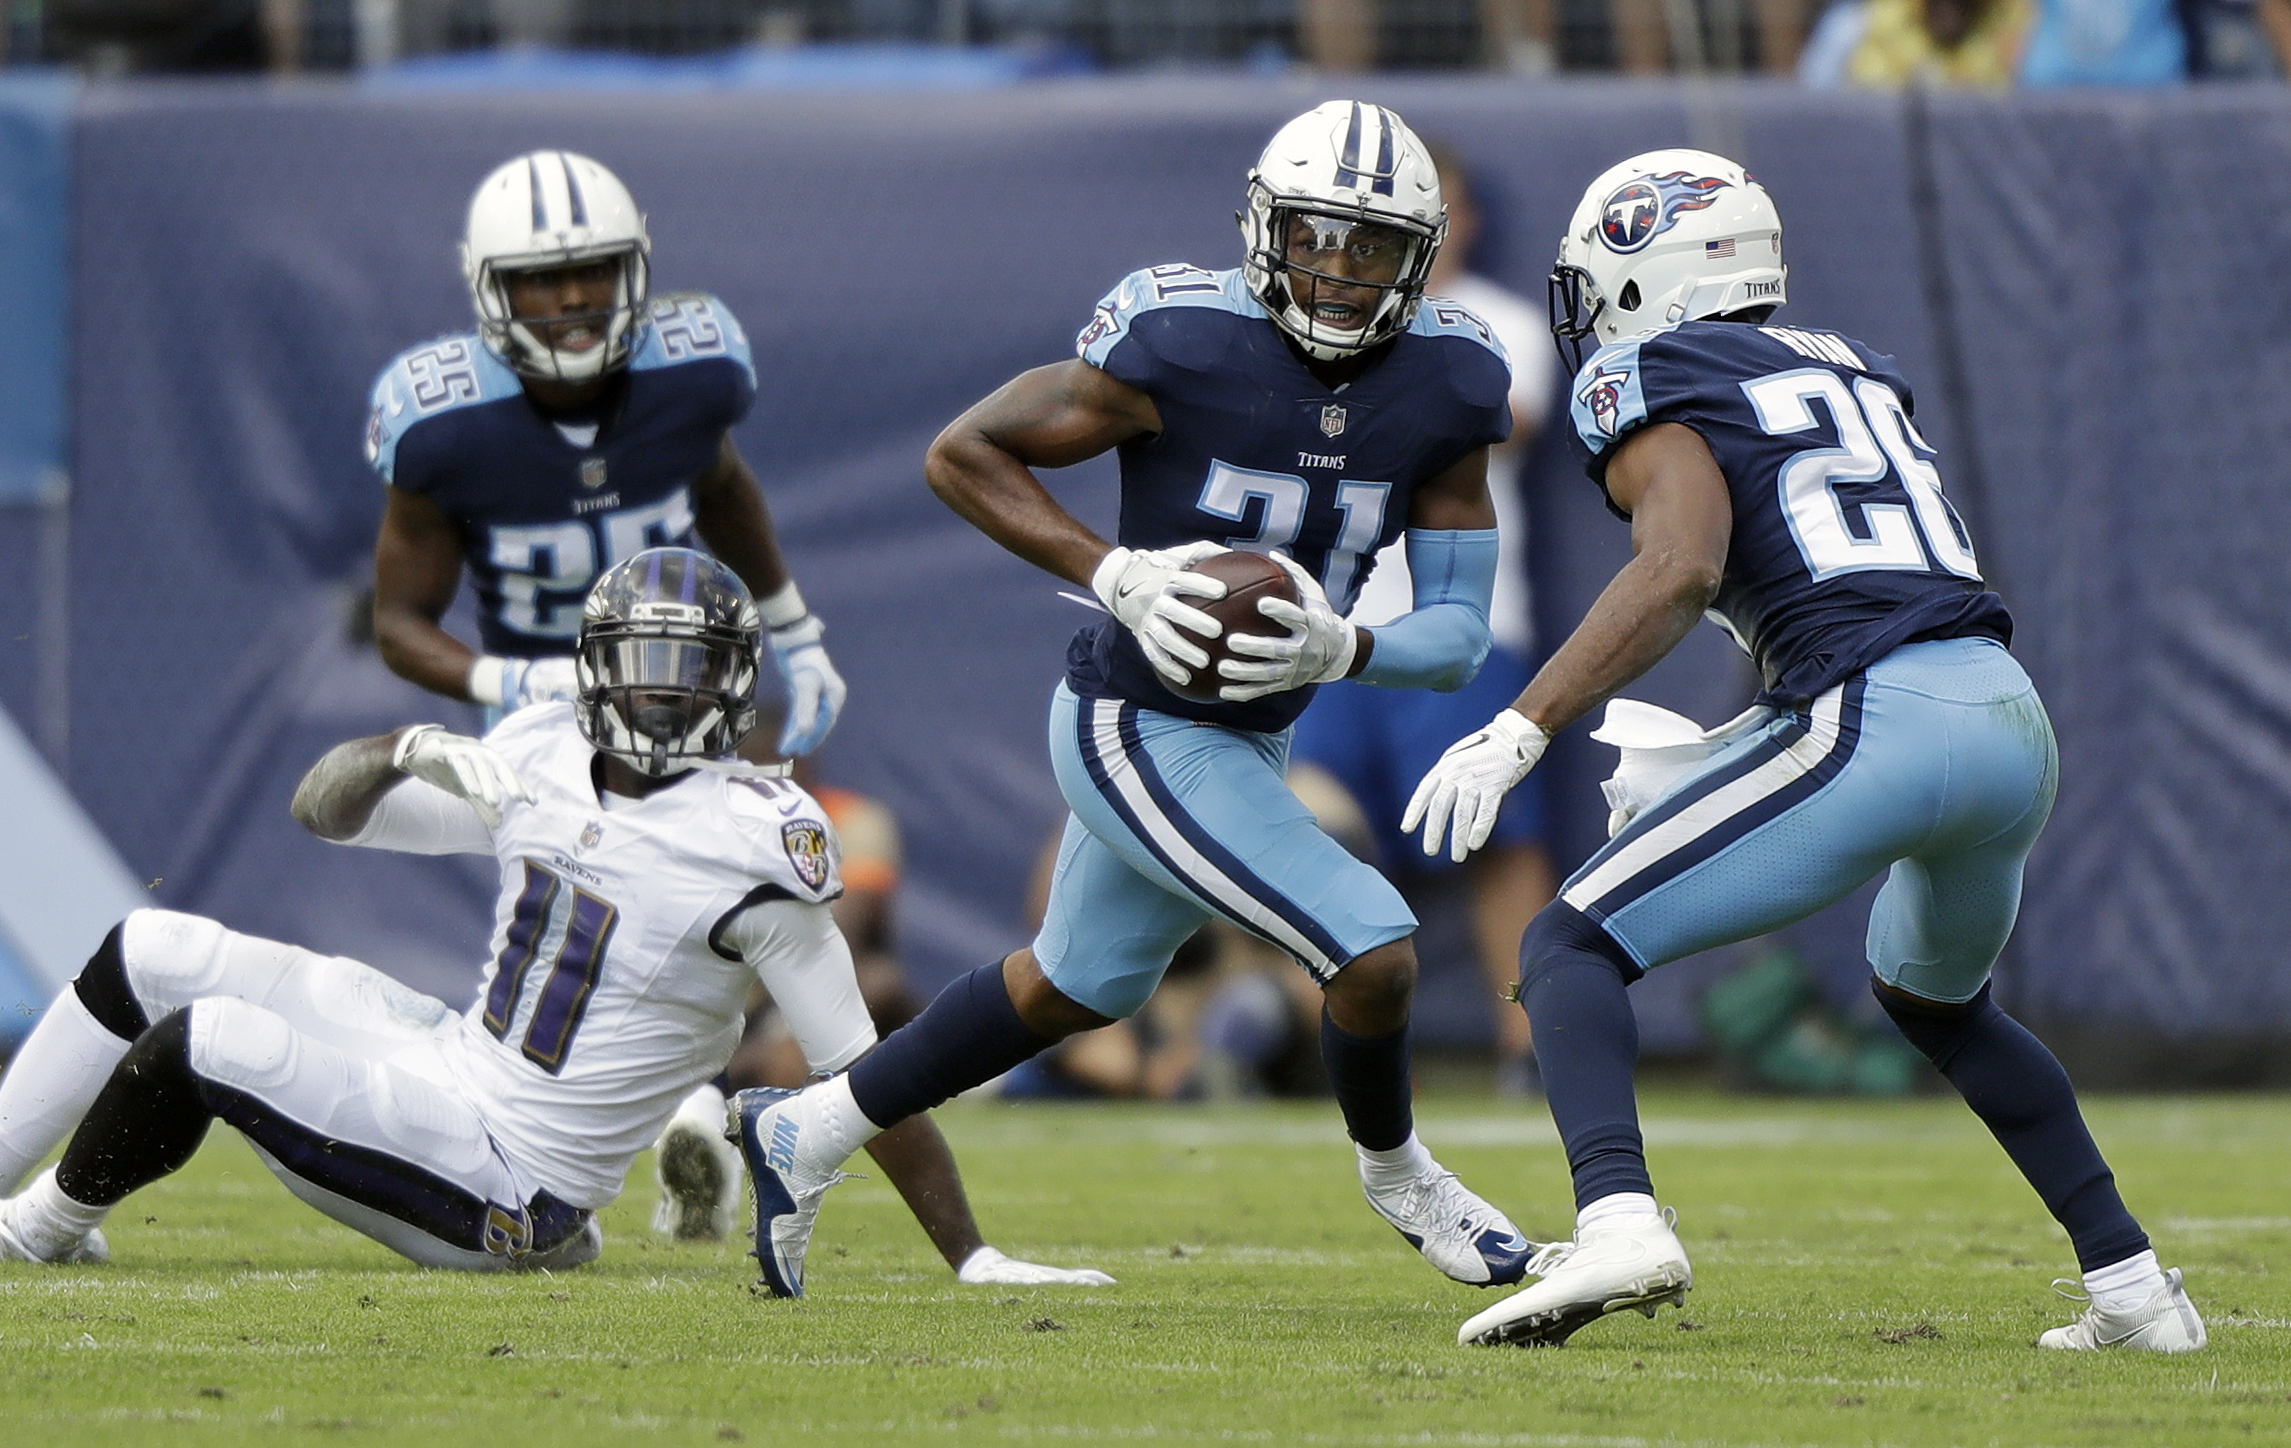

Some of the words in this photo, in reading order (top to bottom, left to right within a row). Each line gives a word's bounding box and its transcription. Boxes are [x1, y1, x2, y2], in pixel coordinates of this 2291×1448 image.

[1744, 278, 1780, 299] TITANS
[404, 338, 481, 414] 25
[1297, 451, 1347, 471] TITANS
[1738, 366, 1984, 584] 26
[553, 855, 603, 886] RAVENS
[482, 857, 621, 1078] 11
[767, 1113, 800, 1177] NIKE
